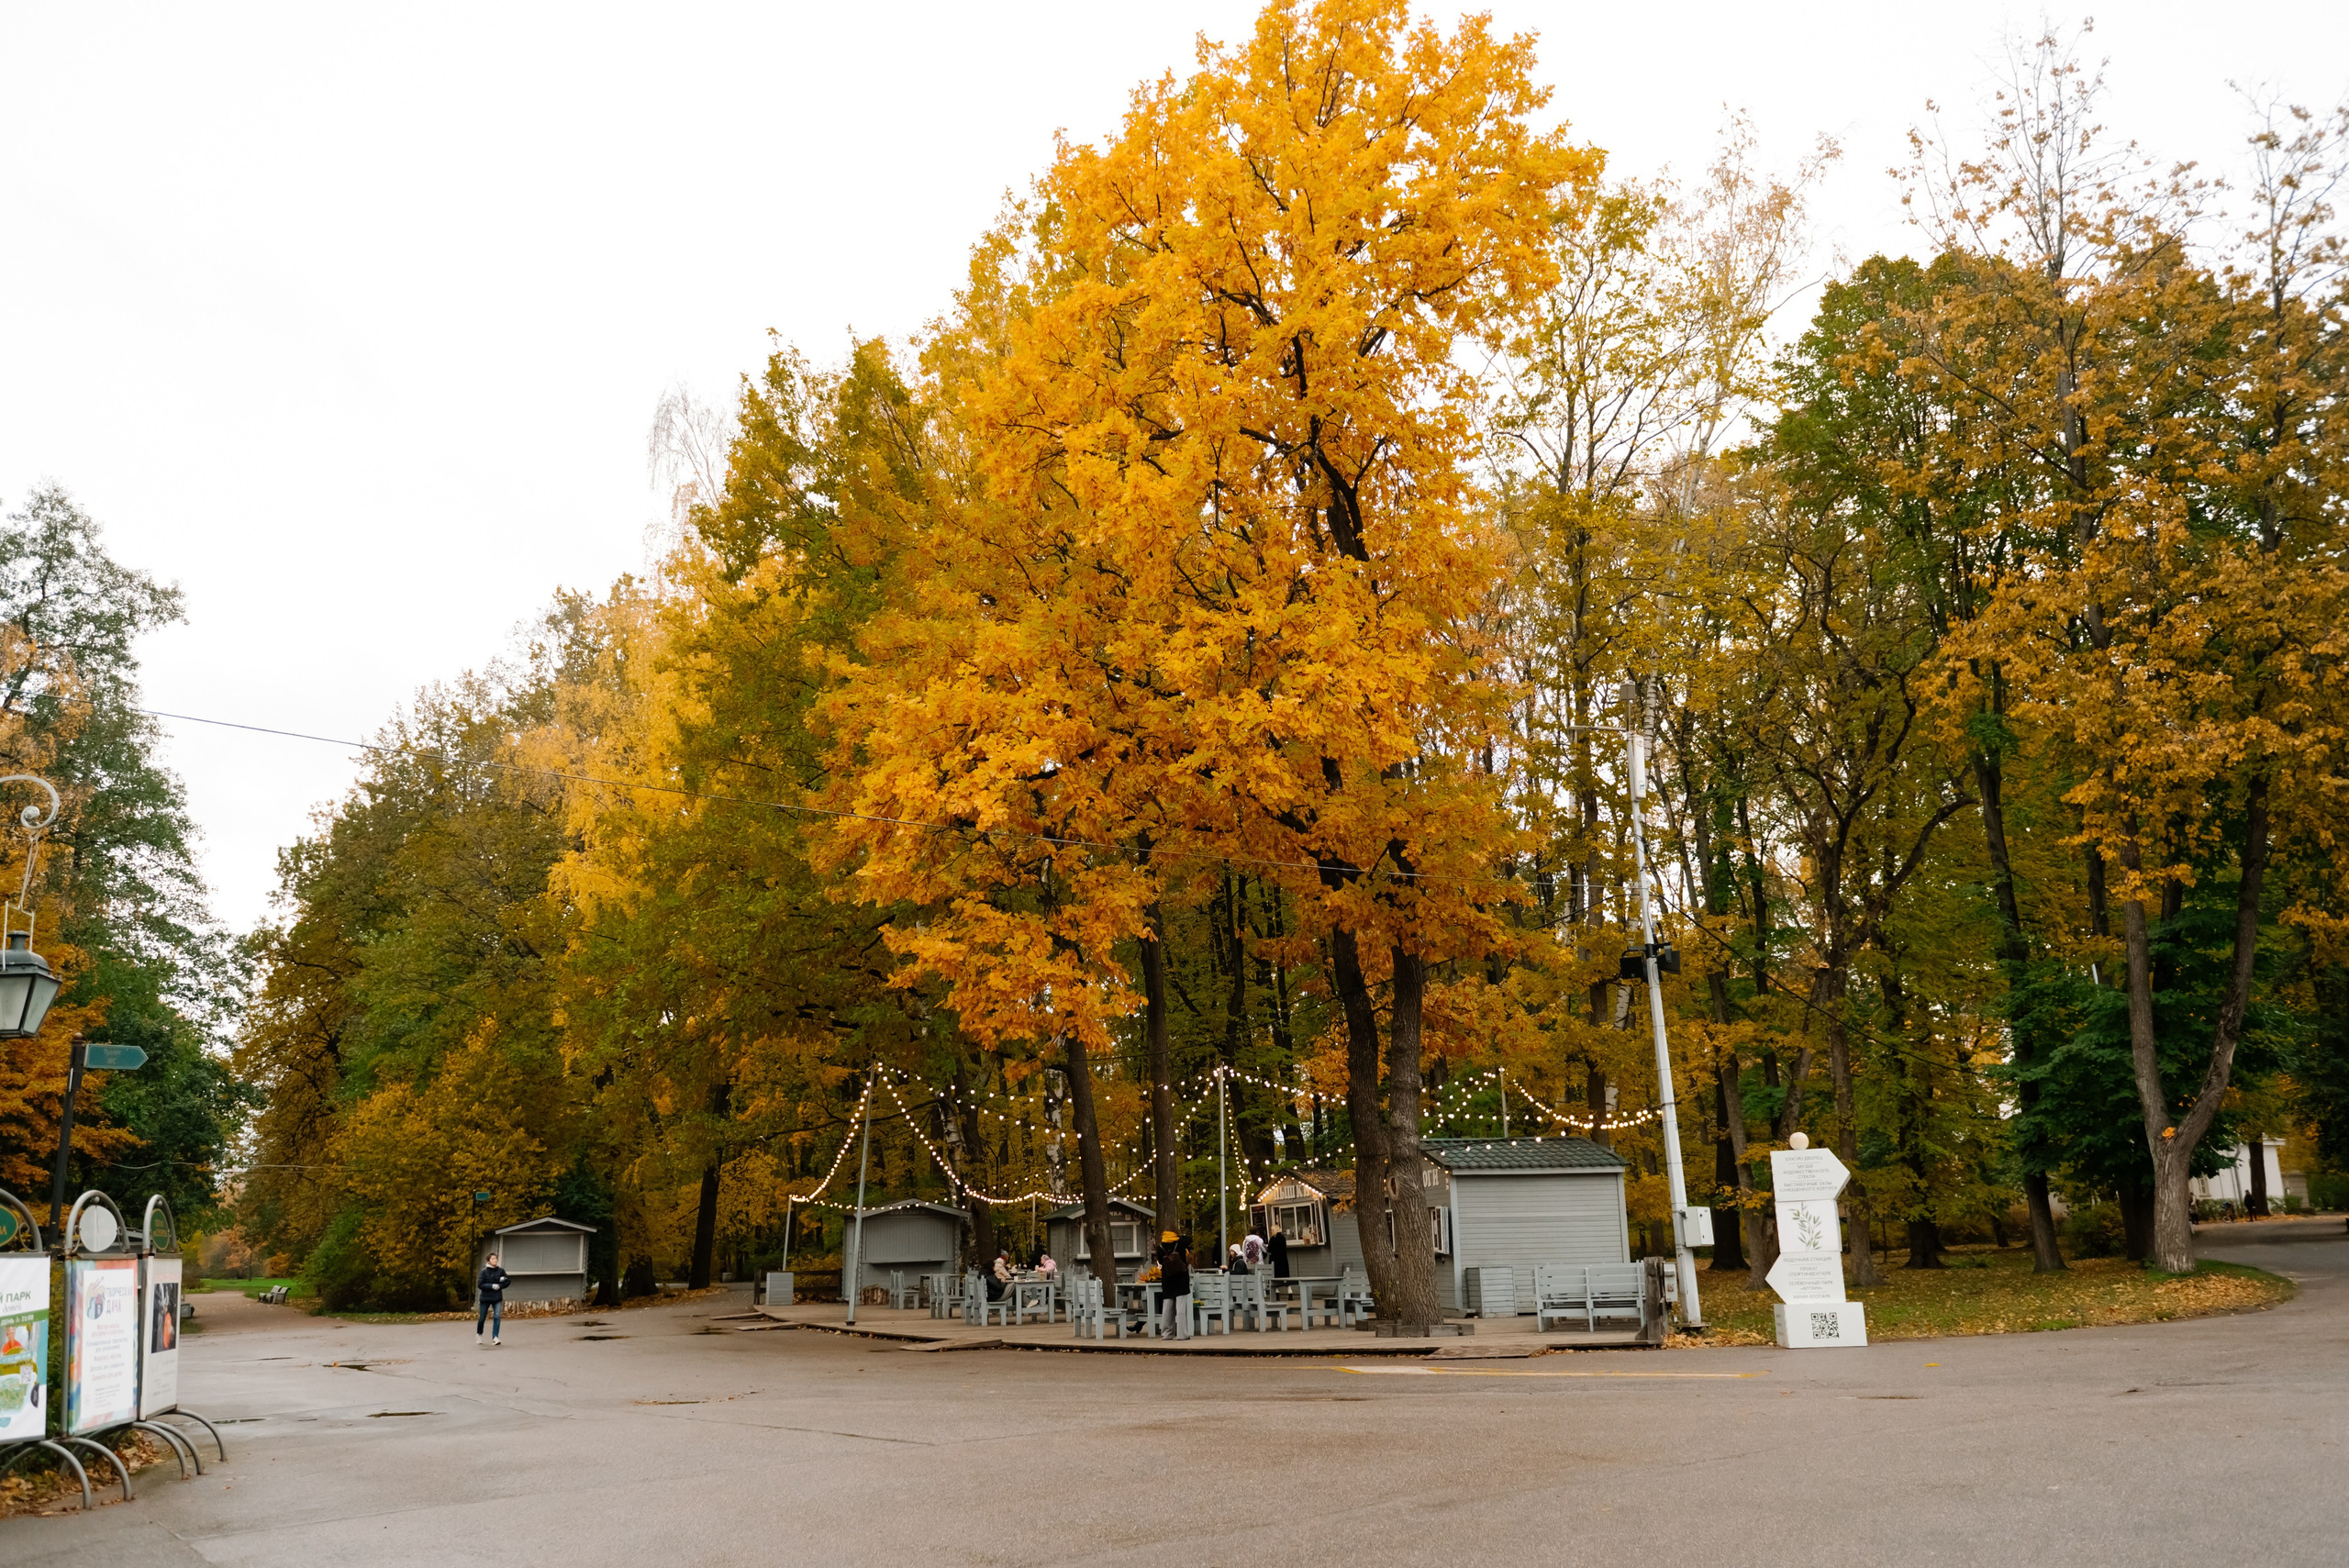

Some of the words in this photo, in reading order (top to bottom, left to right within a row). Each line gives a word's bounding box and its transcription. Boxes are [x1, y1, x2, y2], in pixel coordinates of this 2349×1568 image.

[6, 1290, 31, 1304] ПАРК
[106, 1285, 133, 1297] ТВОРЧЕСКАЯ
[106, 1298, 122, 1315] ДАЧА
[1, 1318, 15, 1326] ДЕНЬ
[21, 1314, 35, 1322] 21:00
